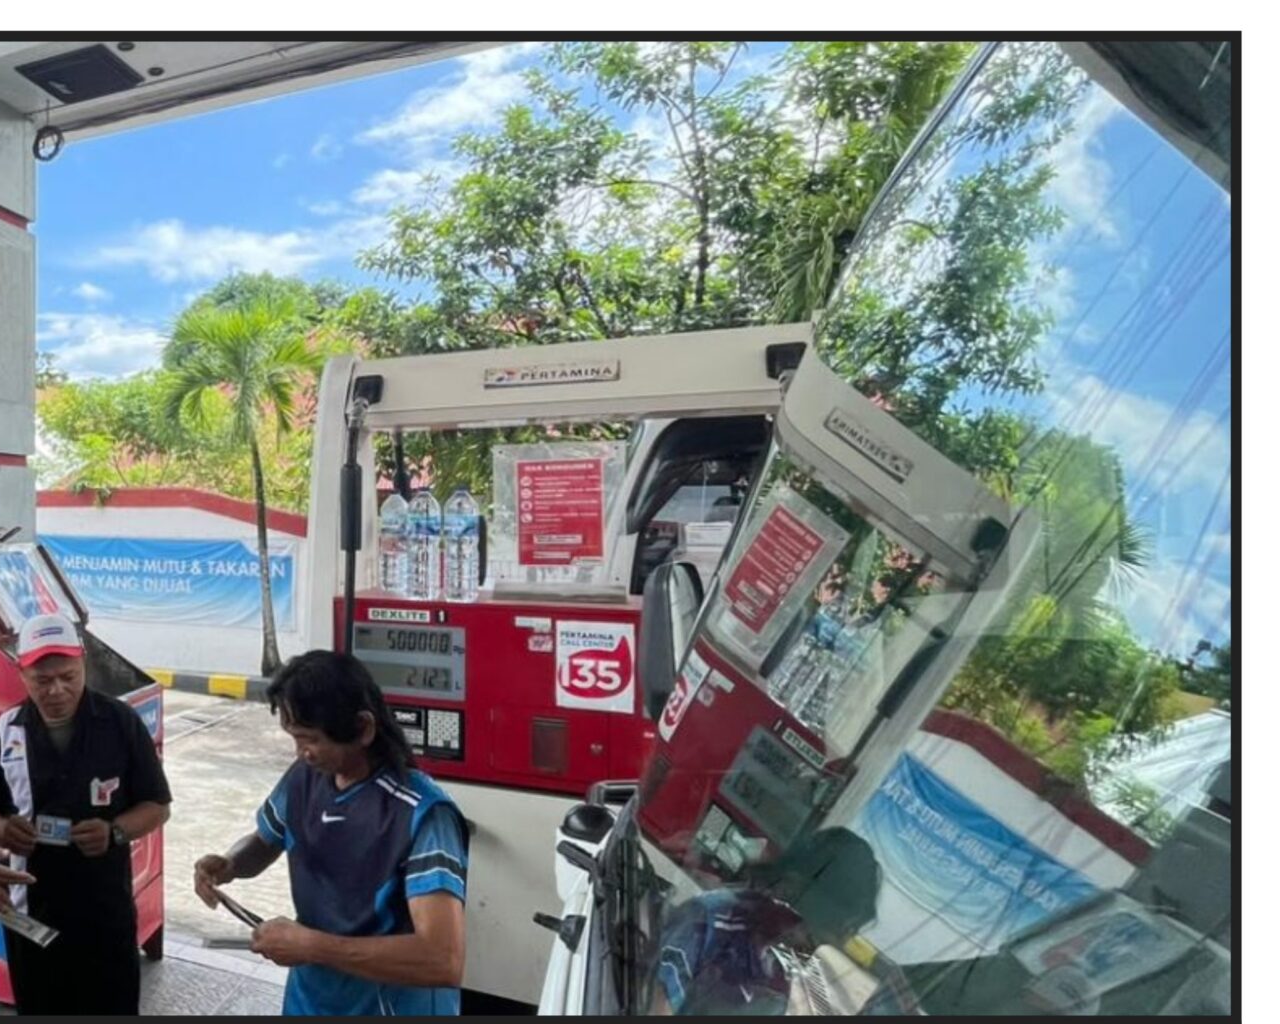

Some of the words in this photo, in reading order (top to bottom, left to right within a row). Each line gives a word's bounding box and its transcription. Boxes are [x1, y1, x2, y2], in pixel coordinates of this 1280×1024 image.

[521, 367, 613, 380] PERTAMINA
[62, 556, 138, 572] MENJAMIN
[143, 559, 186, 575] MUTU
[190, 561, 202, 575] &
[370, 610, 429, 621] DEXLITE
[560, 630, 614, 640] PERTAMINA
[560, 657, 621, 690] 135
